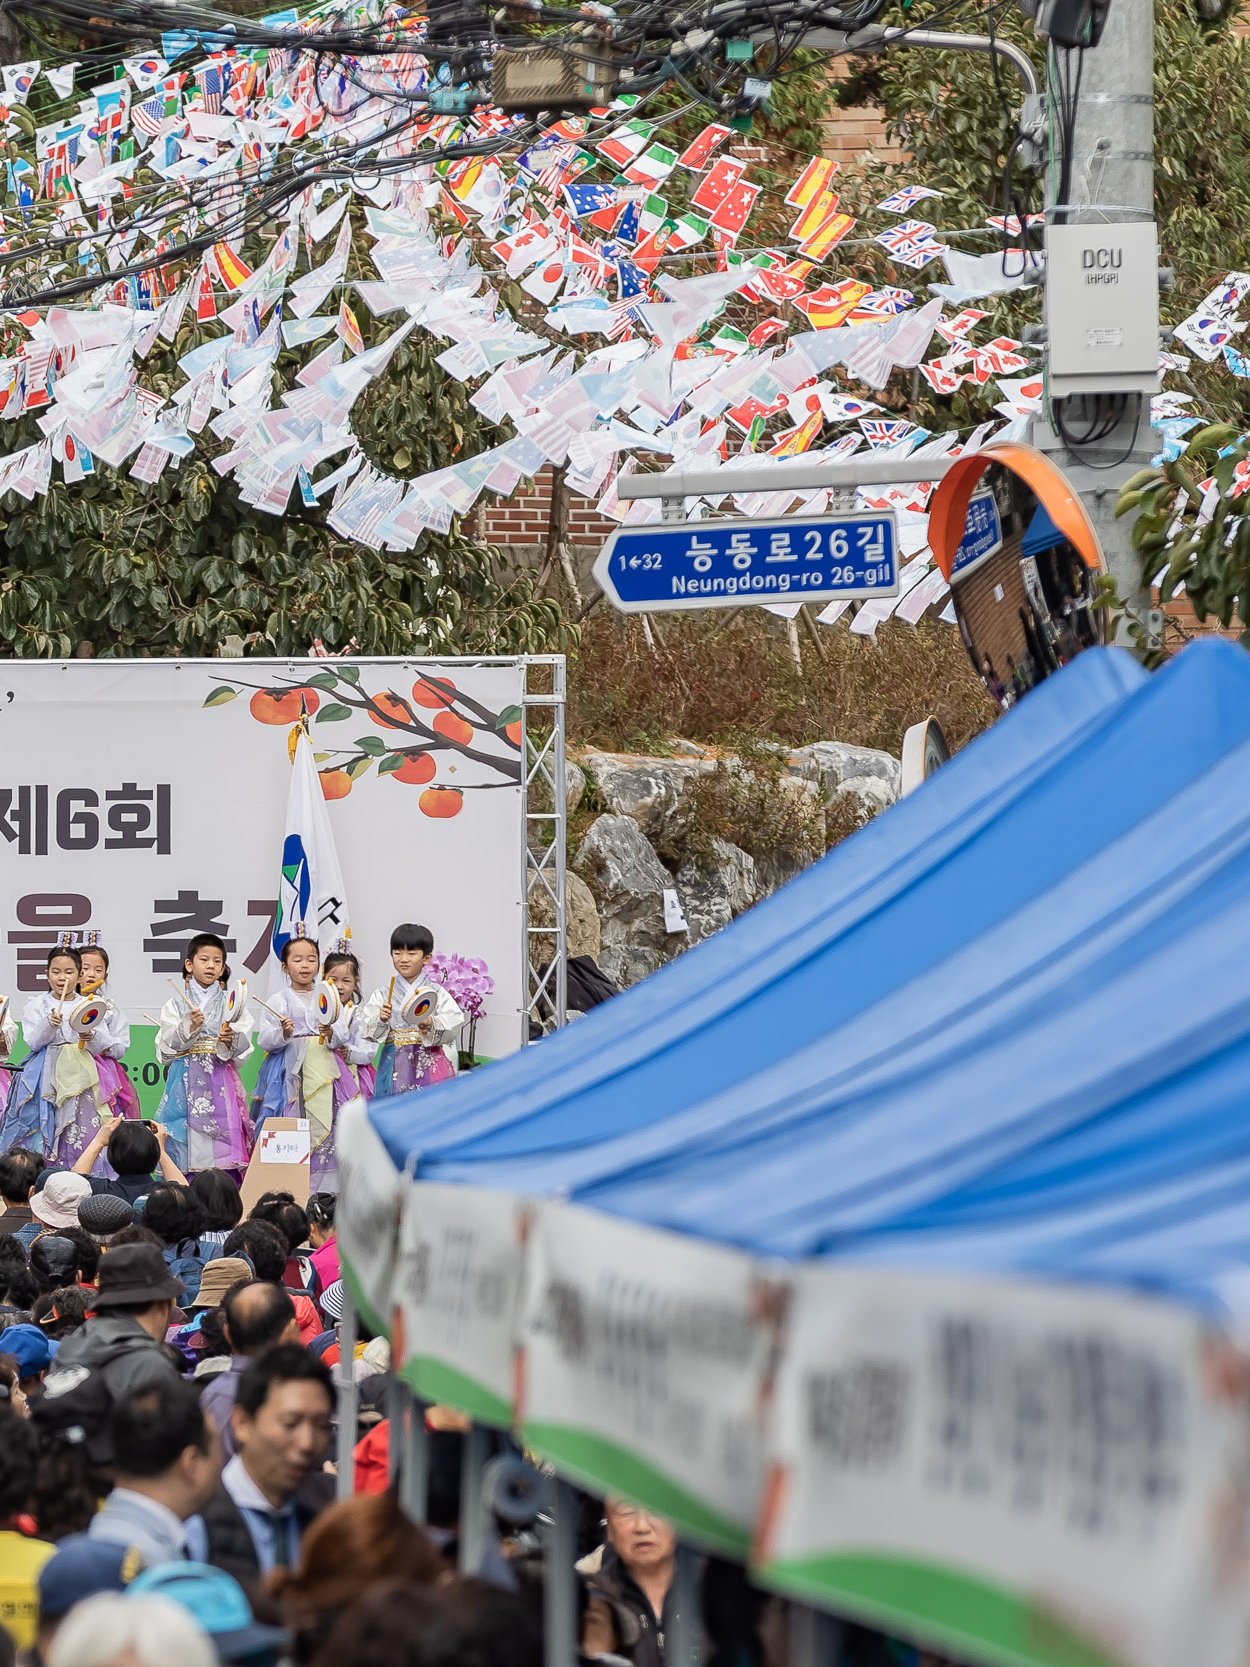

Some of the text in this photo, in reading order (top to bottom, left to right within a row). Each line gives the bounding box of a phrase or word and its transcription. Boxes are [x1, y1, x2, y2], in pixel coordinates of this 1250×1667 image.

[1083, 248, 1123, 269] DCU
[671, 564, 890, 595] Neungdong-ro 26-gil
